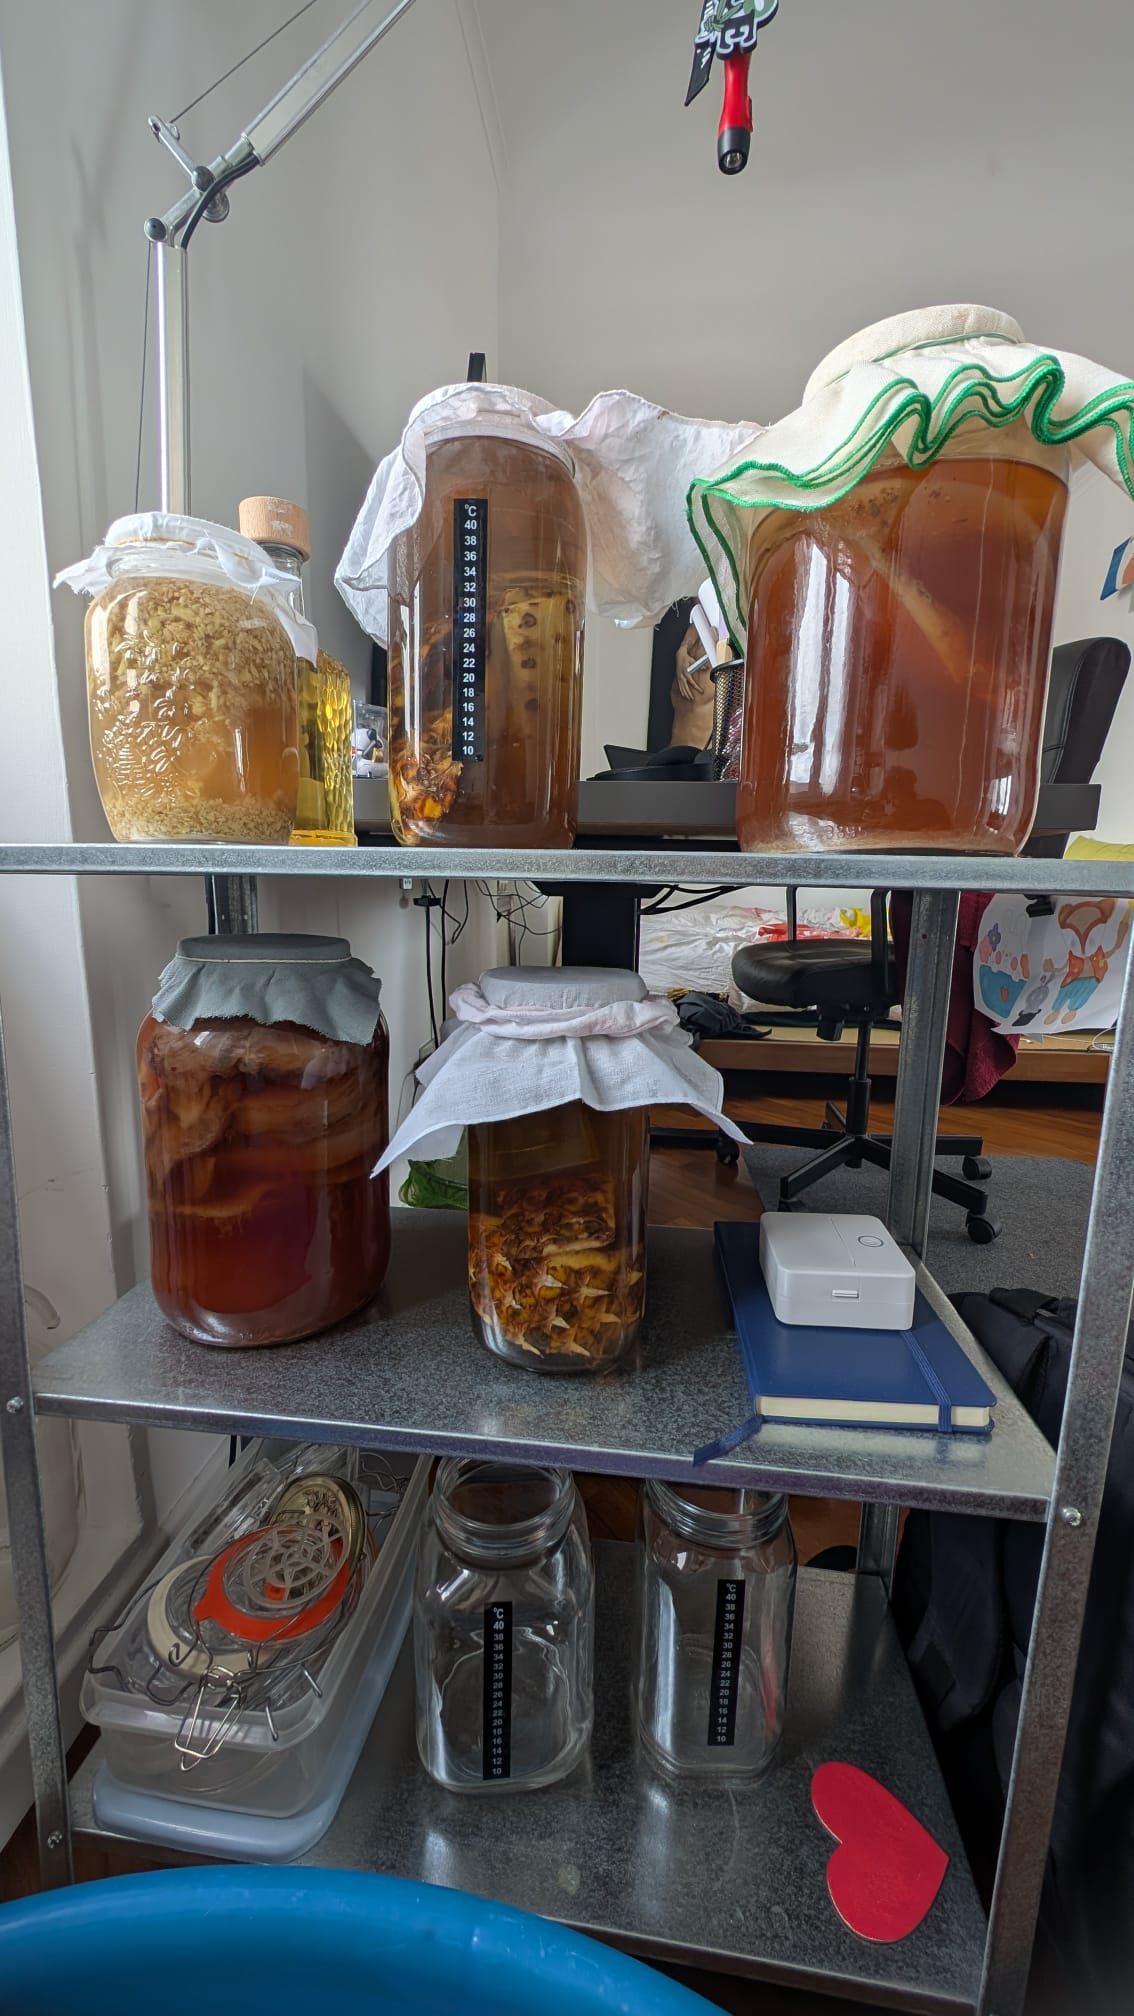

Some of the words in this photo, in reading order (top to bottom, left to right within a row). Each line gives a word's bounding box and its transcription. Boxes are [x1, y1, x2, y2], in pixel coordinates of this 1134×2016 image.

[464, 520, 478, 530] 40
[464, 536, 476, 546] 38
[464, 550, 476, 562] 36
[464, 566, 476, 576] 34
[464, 582, 476, 592] 32
[464, 598, 476, 608] 30
[464, 612, 476, 622] 28
[464, 628, 476, 638] 26
[464, 642, 476, 652] 24
[462, 658, 476, 668] 22
[462, 672, 476, 682] 20
[462, 688, 474, 698] 18
[462, 702, 474, 712] 16
[462, 716, 474, 726] 14
[462, 732, 474, 740] 12
[462, 746, 474, 756] 10
[724, 1612, 736, 1620] 36
[492, 1620, 504, 1630] 40
[724, 1622, 734, 1630] 34
[494, 1652, 504, 1660] 34
[494, 1662, 504, 1670] 32
[720, 1660, 732, 1668] 26
[492, 1672, 504, 1680] 30
[492, 1700, 502, 1708] 24
[492, 1718, 502, 1726] 20
[492, 1746, 502, 1754] 14
[492, 1756, 502, 1766] 12
[492, 1768, 502, 1776] 10
